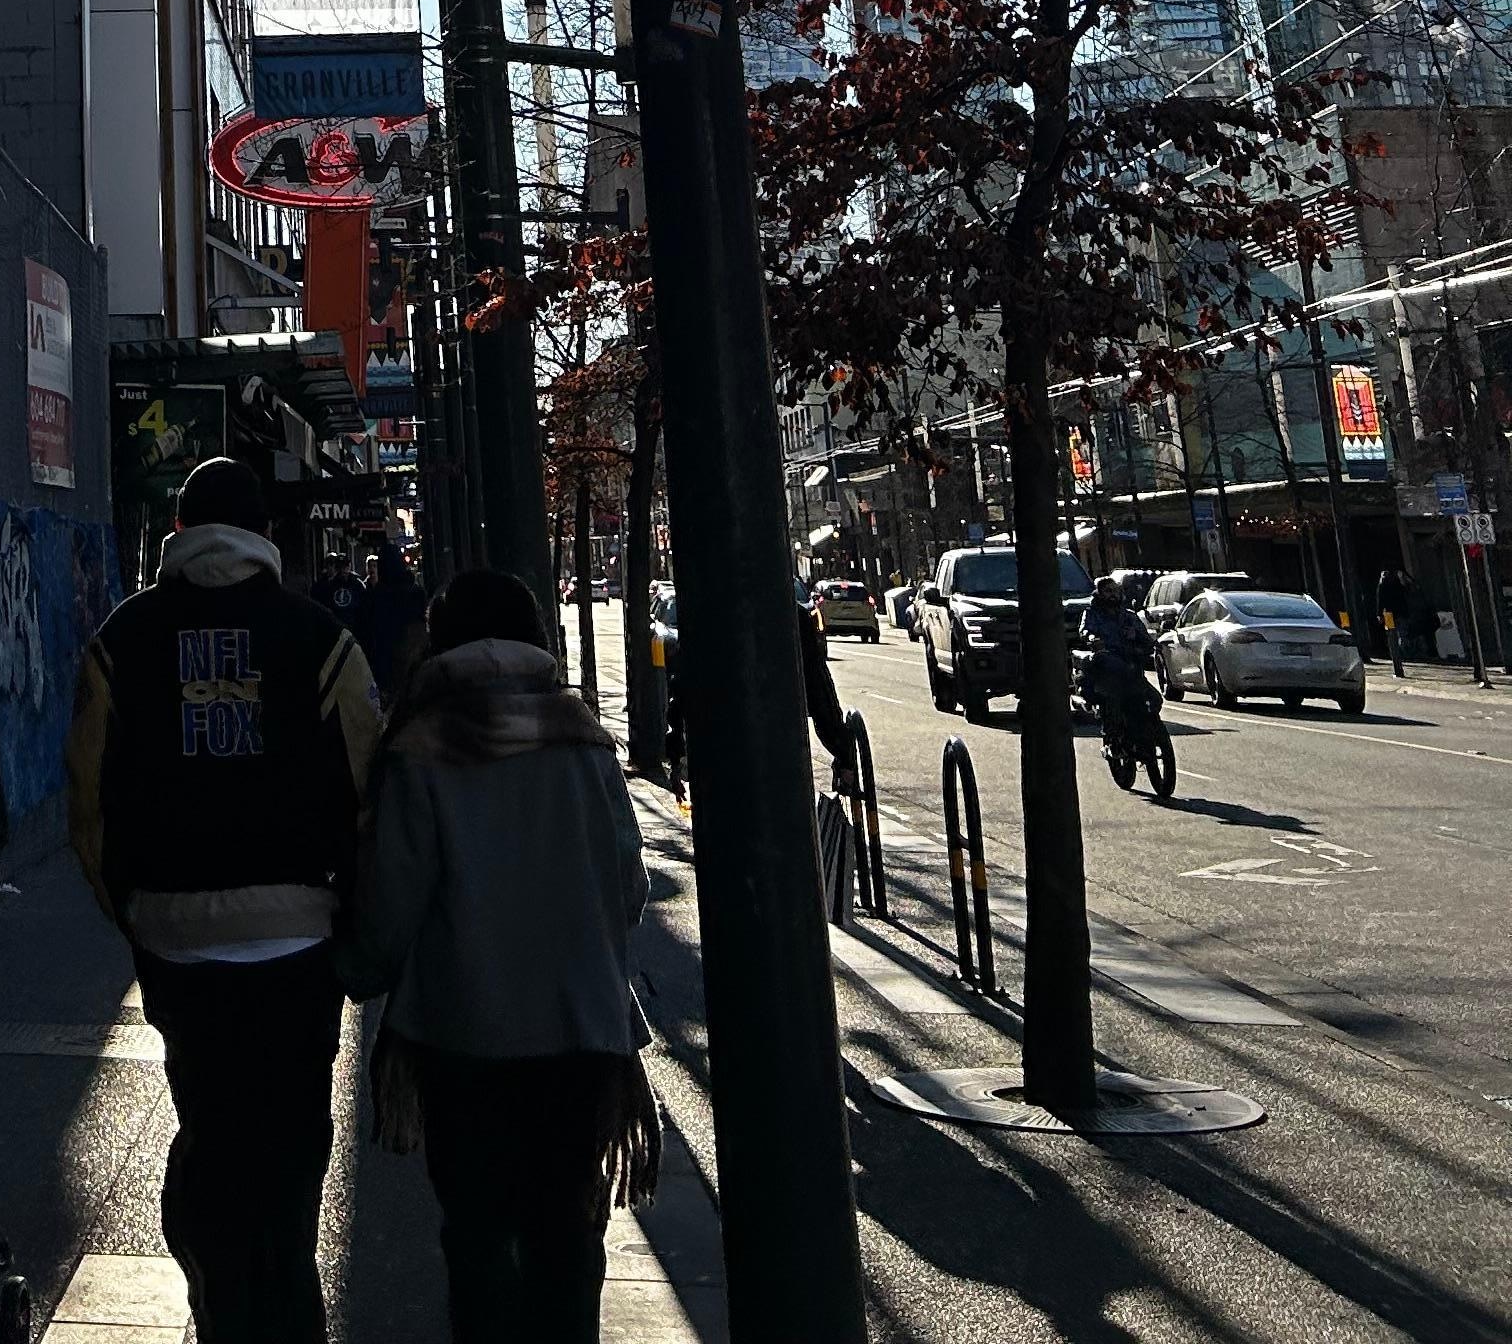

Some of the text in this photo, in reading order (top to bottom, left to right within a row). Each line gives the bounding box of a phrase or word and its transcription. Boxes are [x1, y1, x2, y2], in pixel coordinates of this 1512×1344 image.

[265, 67, 409, 98] GRANVILLE
[242, 132, 434, 196] A&W
[119, 388, 148, 401] Just
[309, 503, 351, 521] ATM
[177, 628, 262, 683] NFL
[181, 700, 264, 757] FOX
